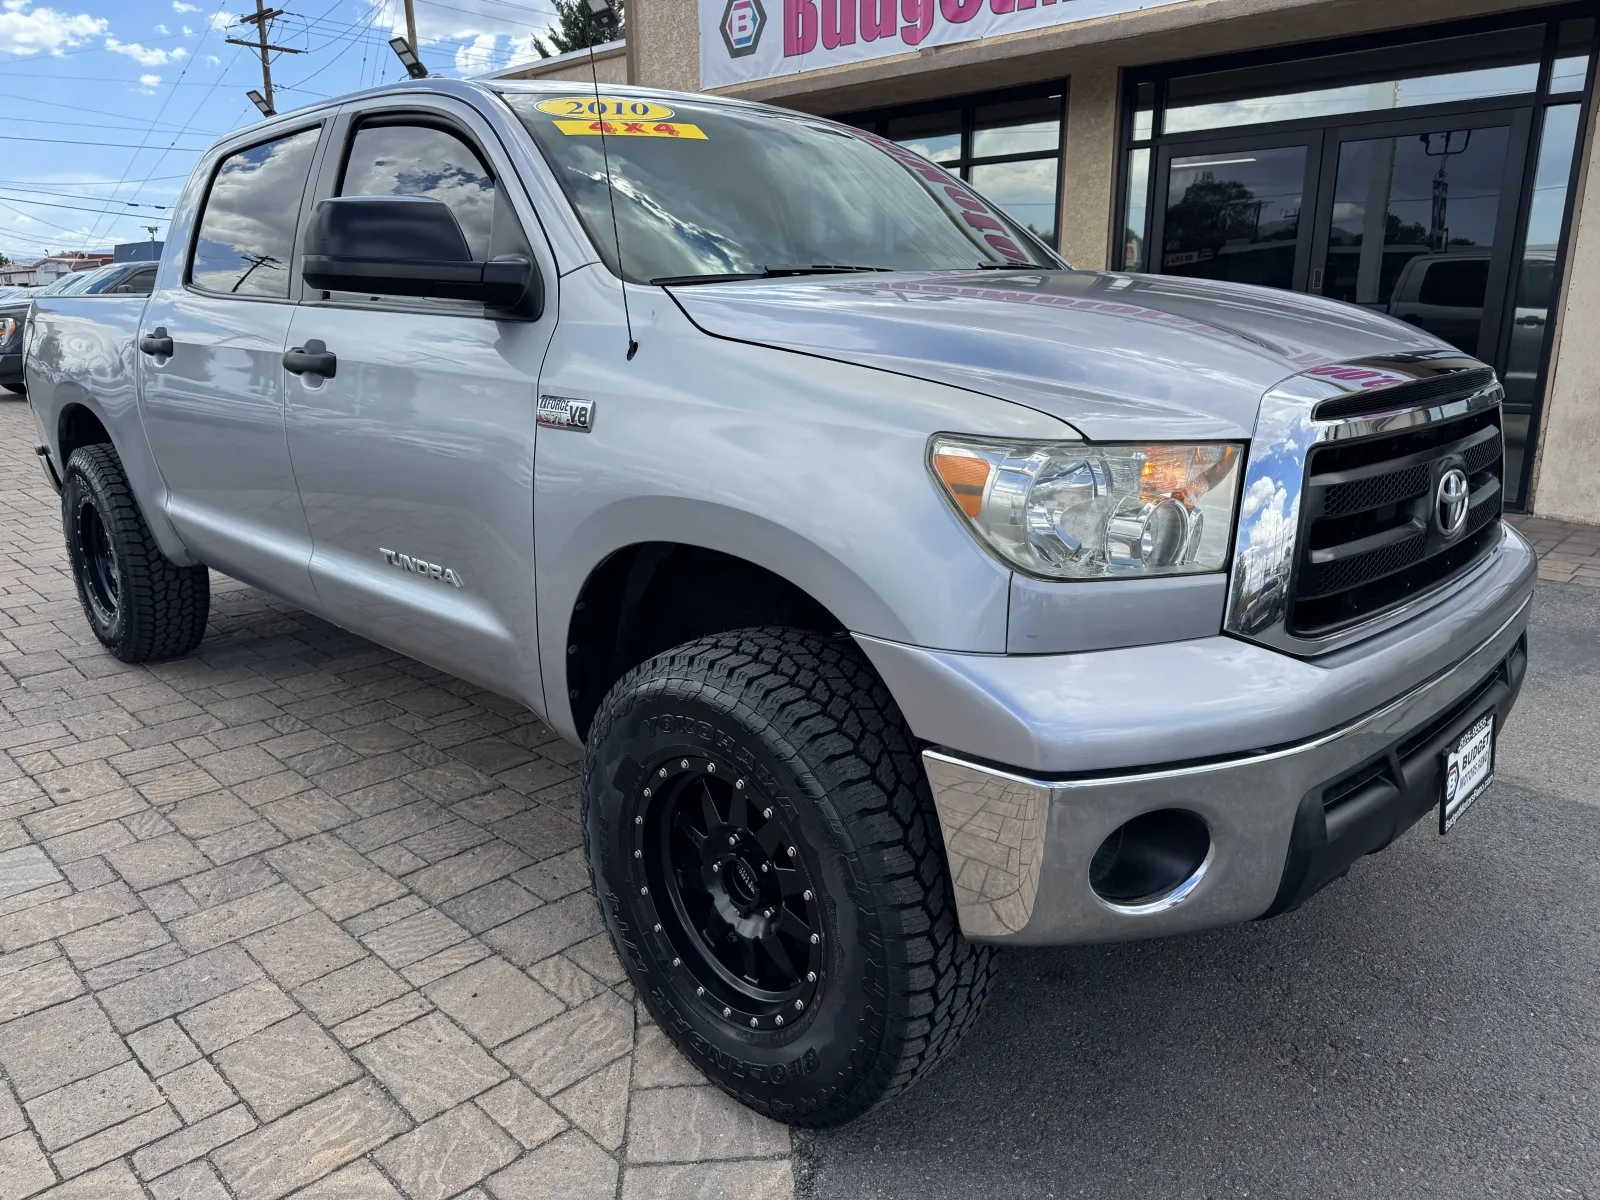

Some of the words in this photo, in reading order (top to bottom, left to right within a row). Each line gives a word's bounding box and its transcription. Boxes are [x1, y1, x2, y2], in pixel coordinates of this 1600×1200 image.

[566, 101, 649, 116] 2010
[569, 405, 588, 427] V8
[379, 547, 465, 588] TUNDRA
[642, 713, 800, 823] YOKOHAMA
[1462, 730, 1490, 771] BUDGET
[651, 986, 820, 1085] GEOLANDAR
